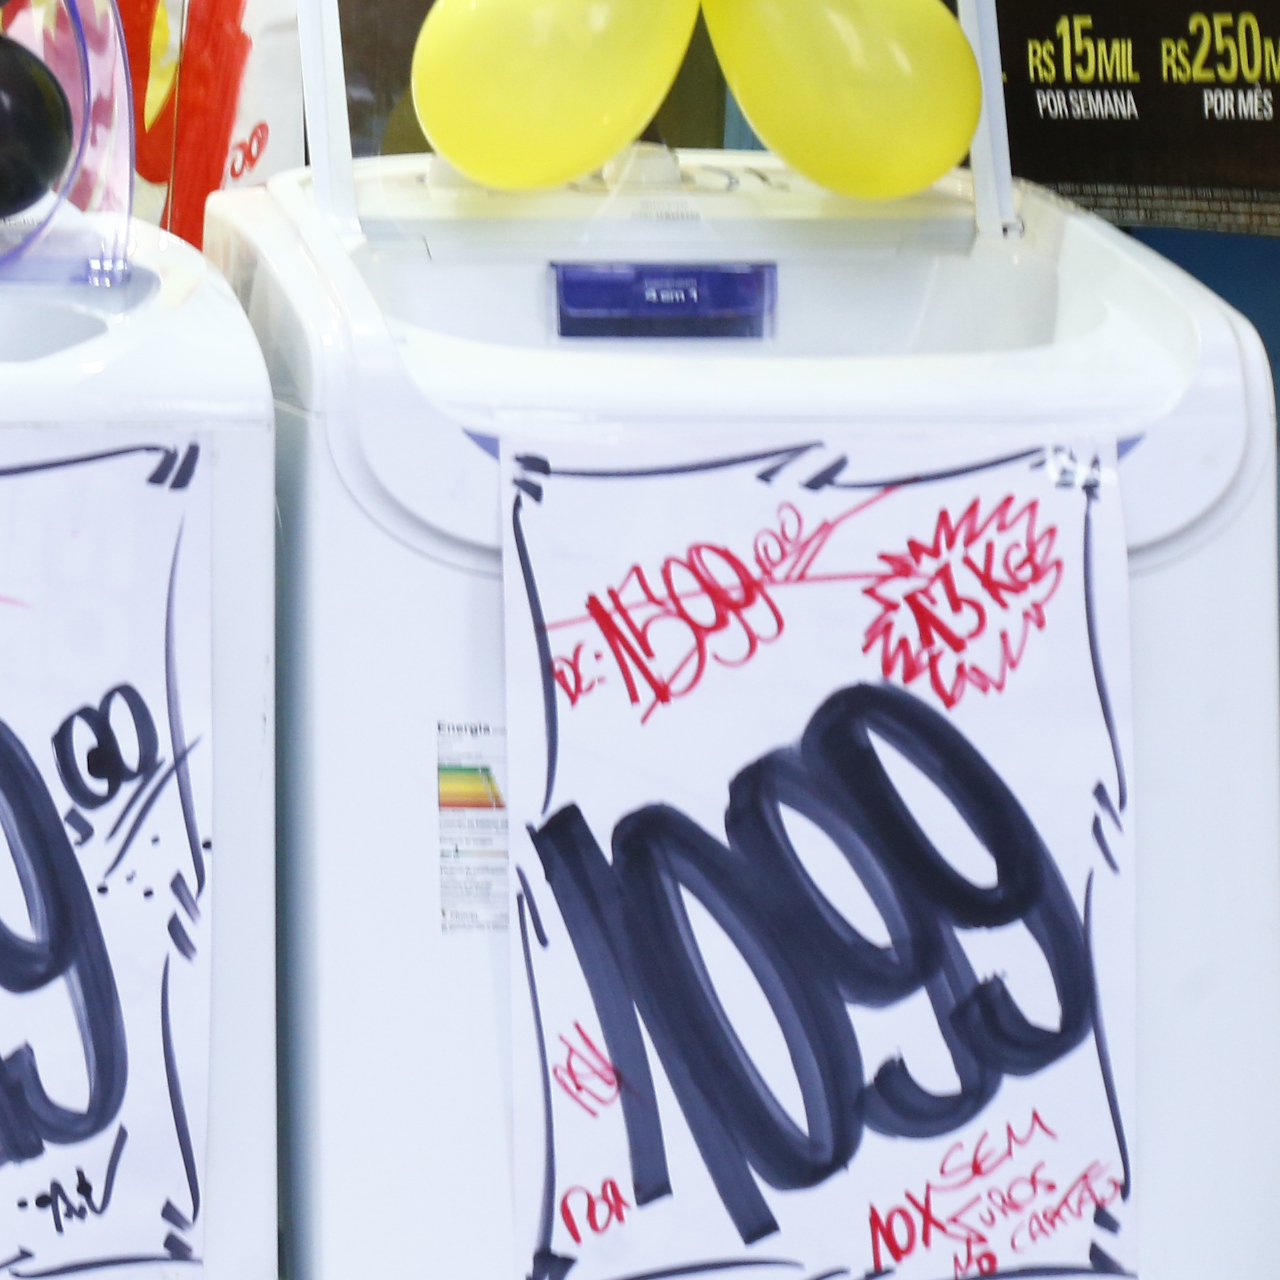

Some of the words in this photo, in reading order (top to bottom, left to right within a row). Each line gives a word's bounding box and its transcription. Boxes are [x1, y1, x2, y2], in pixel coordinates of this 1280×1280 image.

[1036, 89, 1066, 120] POR
[1069, 89, 1139, 120] SEMANA
[1203, 90, 1236, 120] POR
[1238, 81, 1274, 120] MÊS
[527, 681, 1094, 1247] 1099
